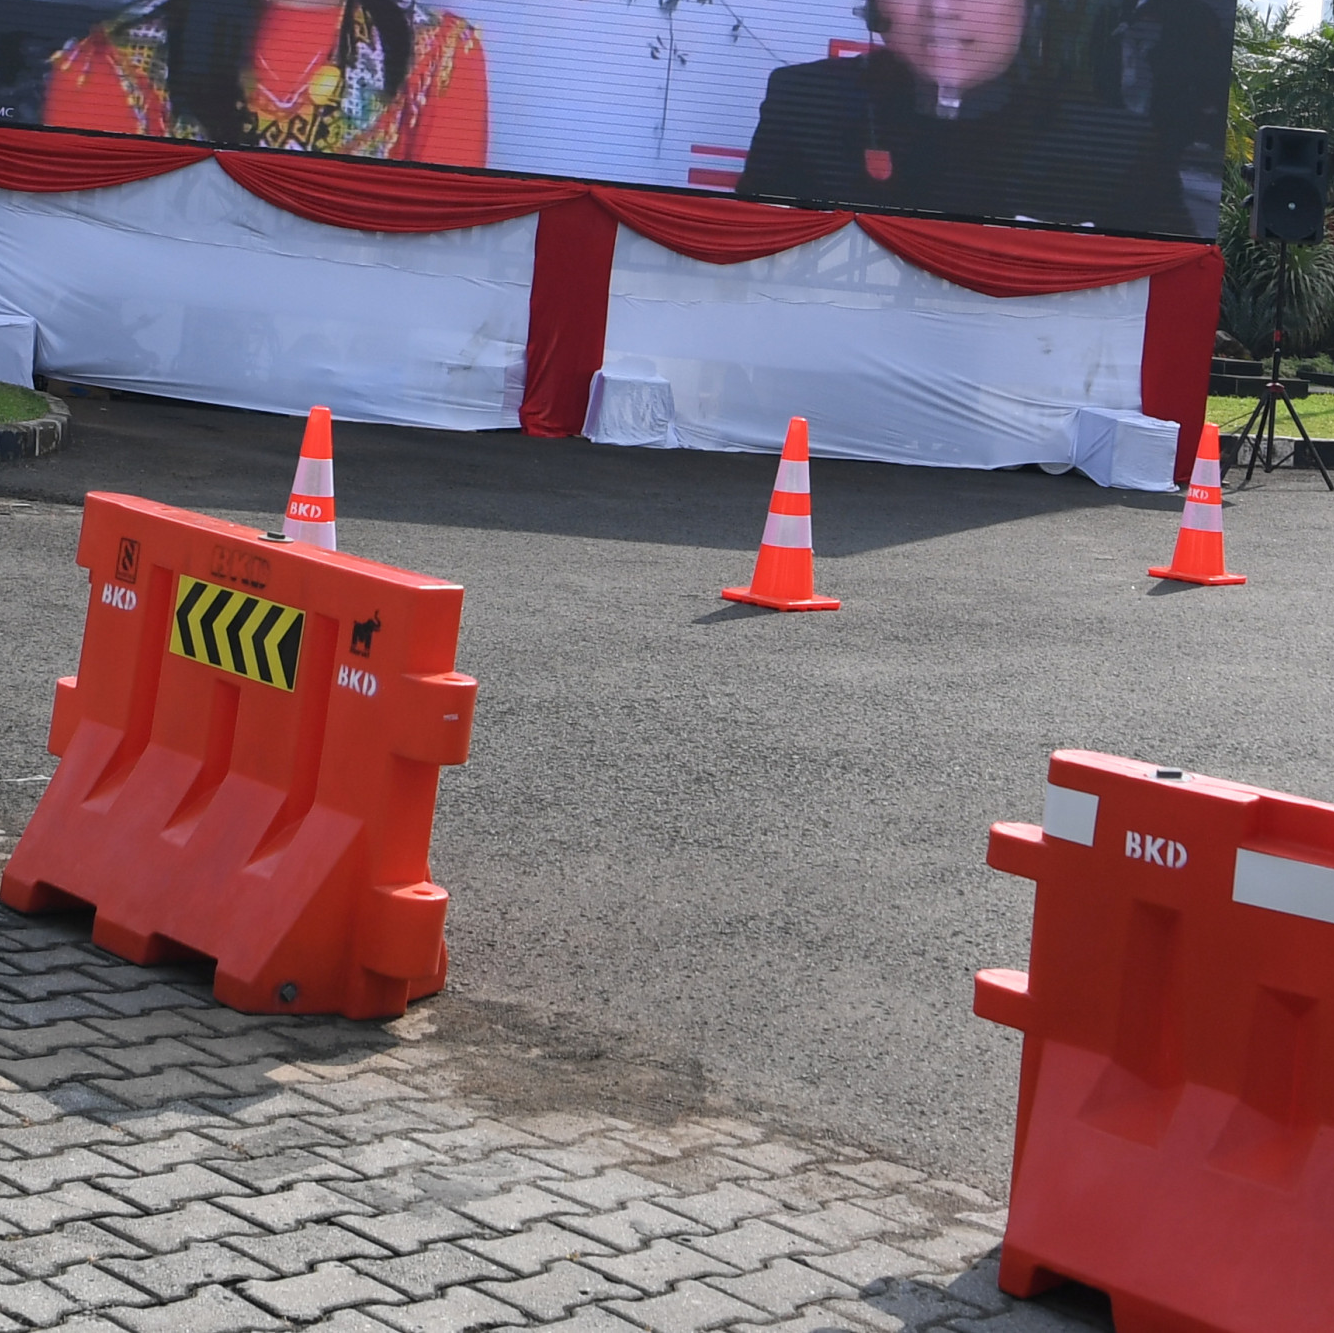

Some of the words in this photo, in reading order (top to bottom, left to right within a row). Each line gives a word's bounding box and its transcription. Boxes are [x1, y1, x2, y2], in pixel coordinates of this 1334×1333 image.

[289, 501, 322, 518] BKD
[101, 582, 138, 611] BKD
[337, 663, 377, 697] BKD
[1124, 830, 1188, 869] BKD
